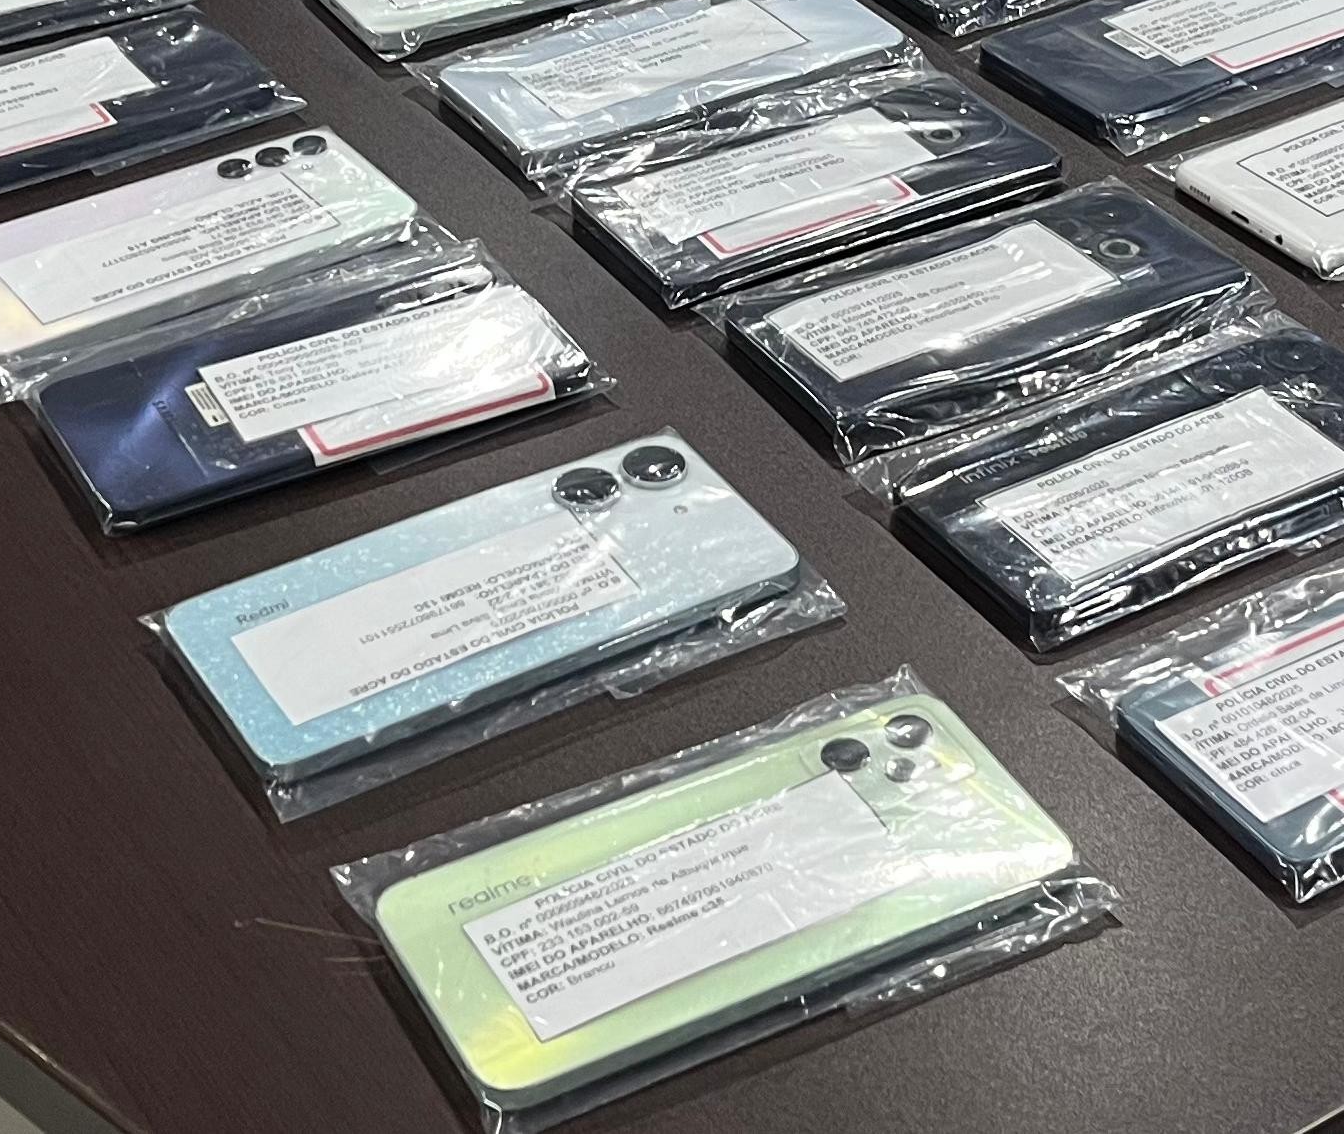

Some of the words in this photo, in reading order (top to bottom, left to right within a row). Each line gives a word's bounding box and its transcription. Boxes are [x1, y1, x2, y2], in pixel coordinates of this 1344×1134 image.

[145, 265, 193, 284] ESTADO
[193, 259, 211, 267] DO
[891, 272, 910, 280] DO
[908, 258, 952, 277] ESTADO
[950, 253, 970, 262] DO
[125, 281, 144, 290] DO
[256, 343, 306, 360] POLÍCIA
[341, 330, 359, 338] DO
[361, 316, 411, 333] ESTADO
[411, 311, 430, 320] DO
[839, 334, 859, 344] DO
[256, 387, 276, 395] DO
[1035, 466, 1083, 489] POLÍCIA
[1111, 449, 1130, 459] DO
[1129, 431, 1175, 452] ESTADO
[1174, 424, 1193, 434] DO
[1192, 412, 1224, 427] ACRE
[958, 455, 1021, 485] Infinix
[1039, 532, 1067, 546] IMEI
[1064, 525, 1085, 535] DO
[549, 561, 569, 572] DO
[439, 581, 482, 602] REDMI
[234, 597, 291, 625] Redmi
[527, 601, 579, 627] POLÍCIA
[469, 635, 490, 647] DO
[492, 621, 526, 638] CIVIL
[412, 644, 468, 671] ESTADO
[348, 676, 388, 696] ACRE
[389, 667, 411, 680] DO
[1263, 672, 1296, 689] CIVIL
[1295, 663, 1316, 675] DO
[1275, 696, 1308, 714] Sales
[1306, 688, 1324, 699] de
[1238, 746, 1261, 760] DO
[595, 862, 633, 882] CIVIL
[634, 852, 657, 866] DO
[719, 819, 741, 832] DO
[447, 874, 534, 915] realme
[506, 959, 541, 979] IMEI
[541, 948, 567, 964] DO
[567, 911, 656, 954] APARELHO:
[515, 931, 645, 990] MARCA/MODELO:
[524, 981, 565, 1003] COR:
[566, 959, 616, 985] Branco
